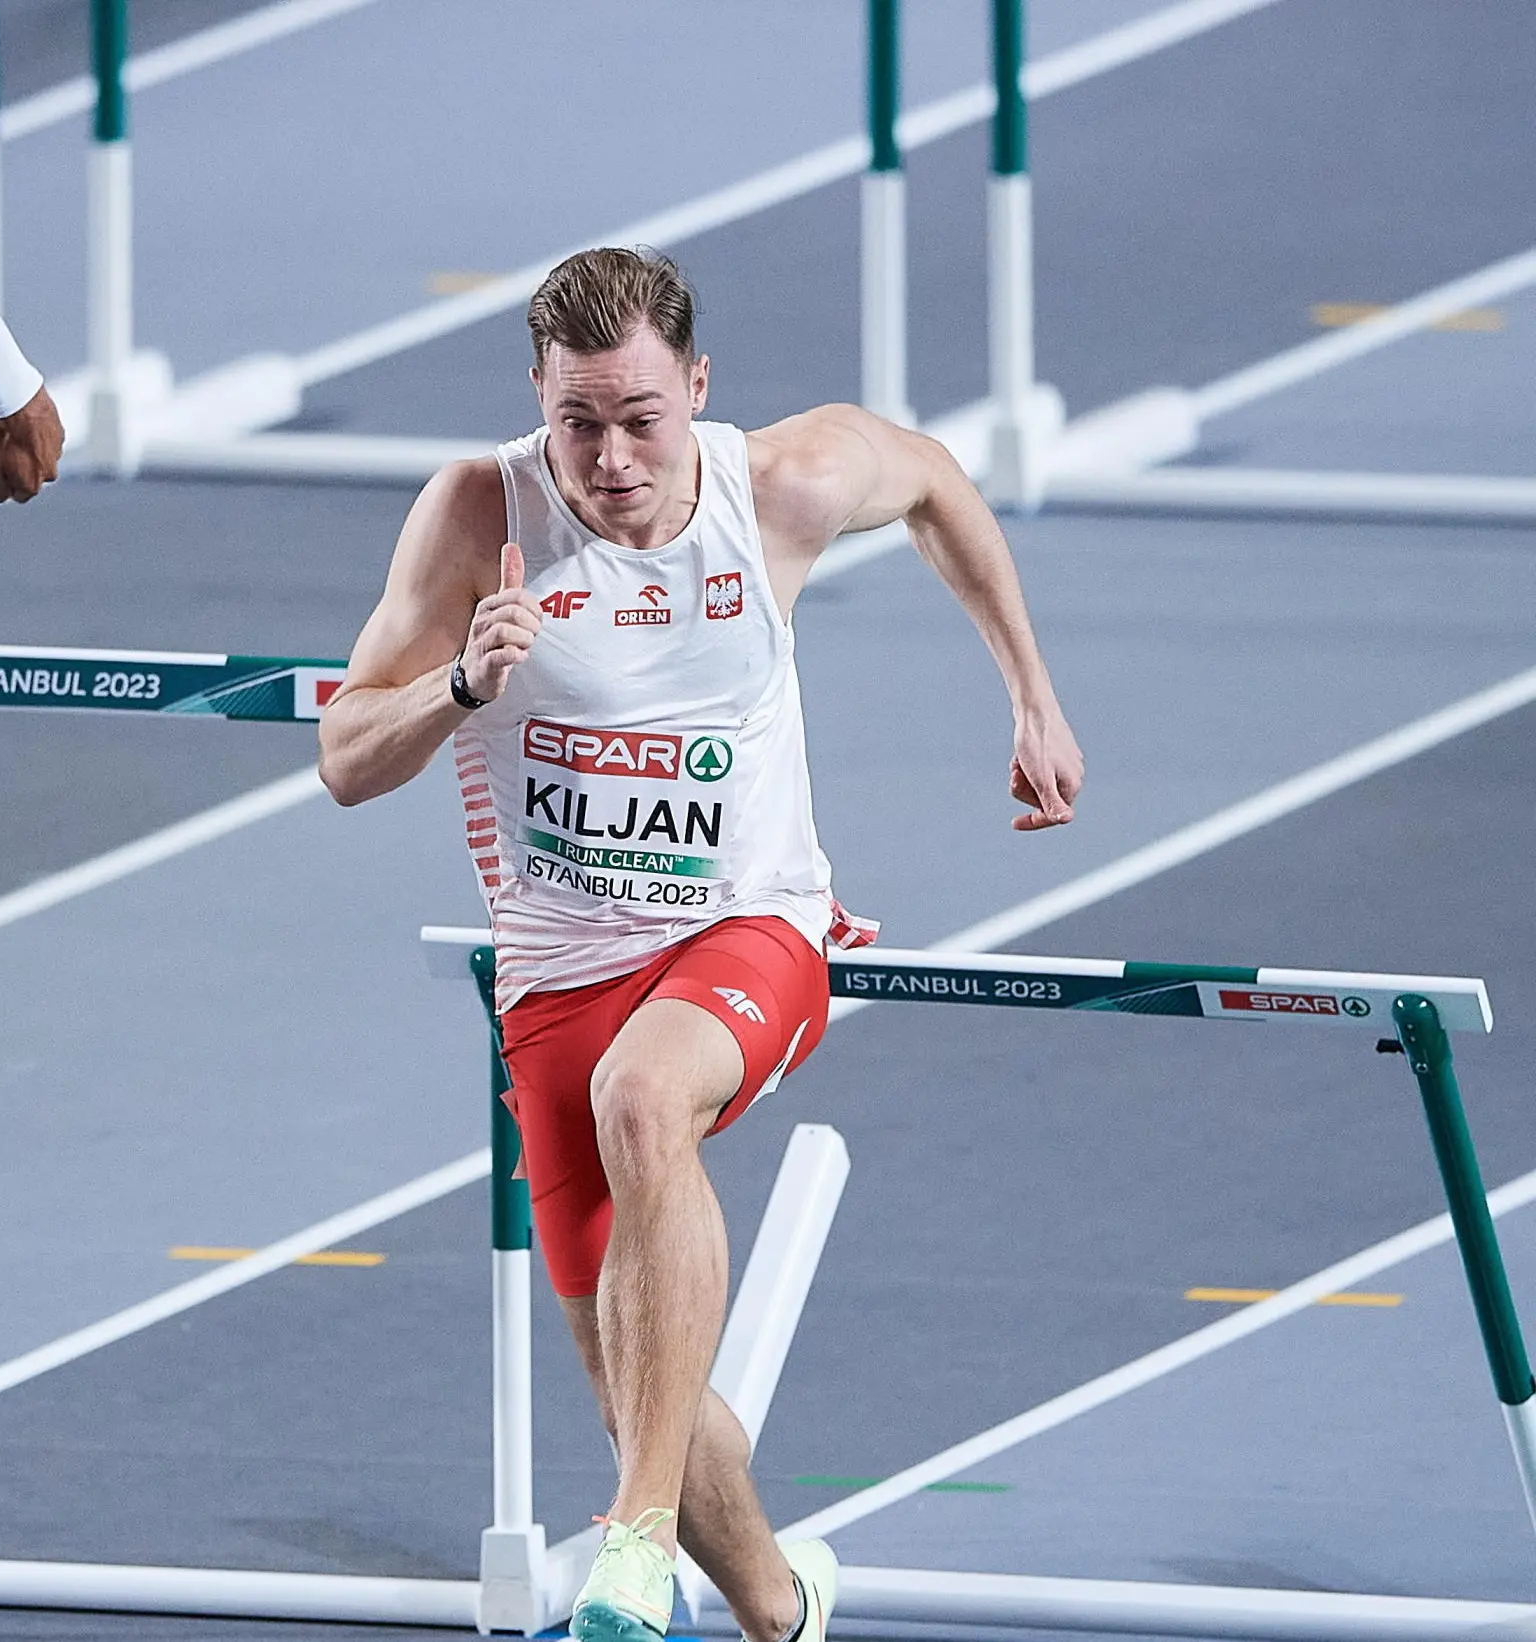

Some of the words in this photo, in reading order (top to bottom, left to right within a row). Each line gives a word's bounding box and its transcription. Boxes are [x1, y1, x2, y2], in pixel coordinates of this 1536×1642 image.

[617, 611, 667, 624] ORLEN
[93, 672, 161, 698] 2023
[529, 724, 677, 774] SPAR
[525, 777, 722, 847] KILJAN
[557, 840, 563, 853] I
[565, 844, 603, 864] RUN
[526, 854, 640, 902] ISTANBUL
[646, 881, 709, 906] 2023
[845, 972, 988, 997] ISTANBUL
[995, 978, 1061, 1000] 2023
[1249, 994, 1340, 1013] SPAR
